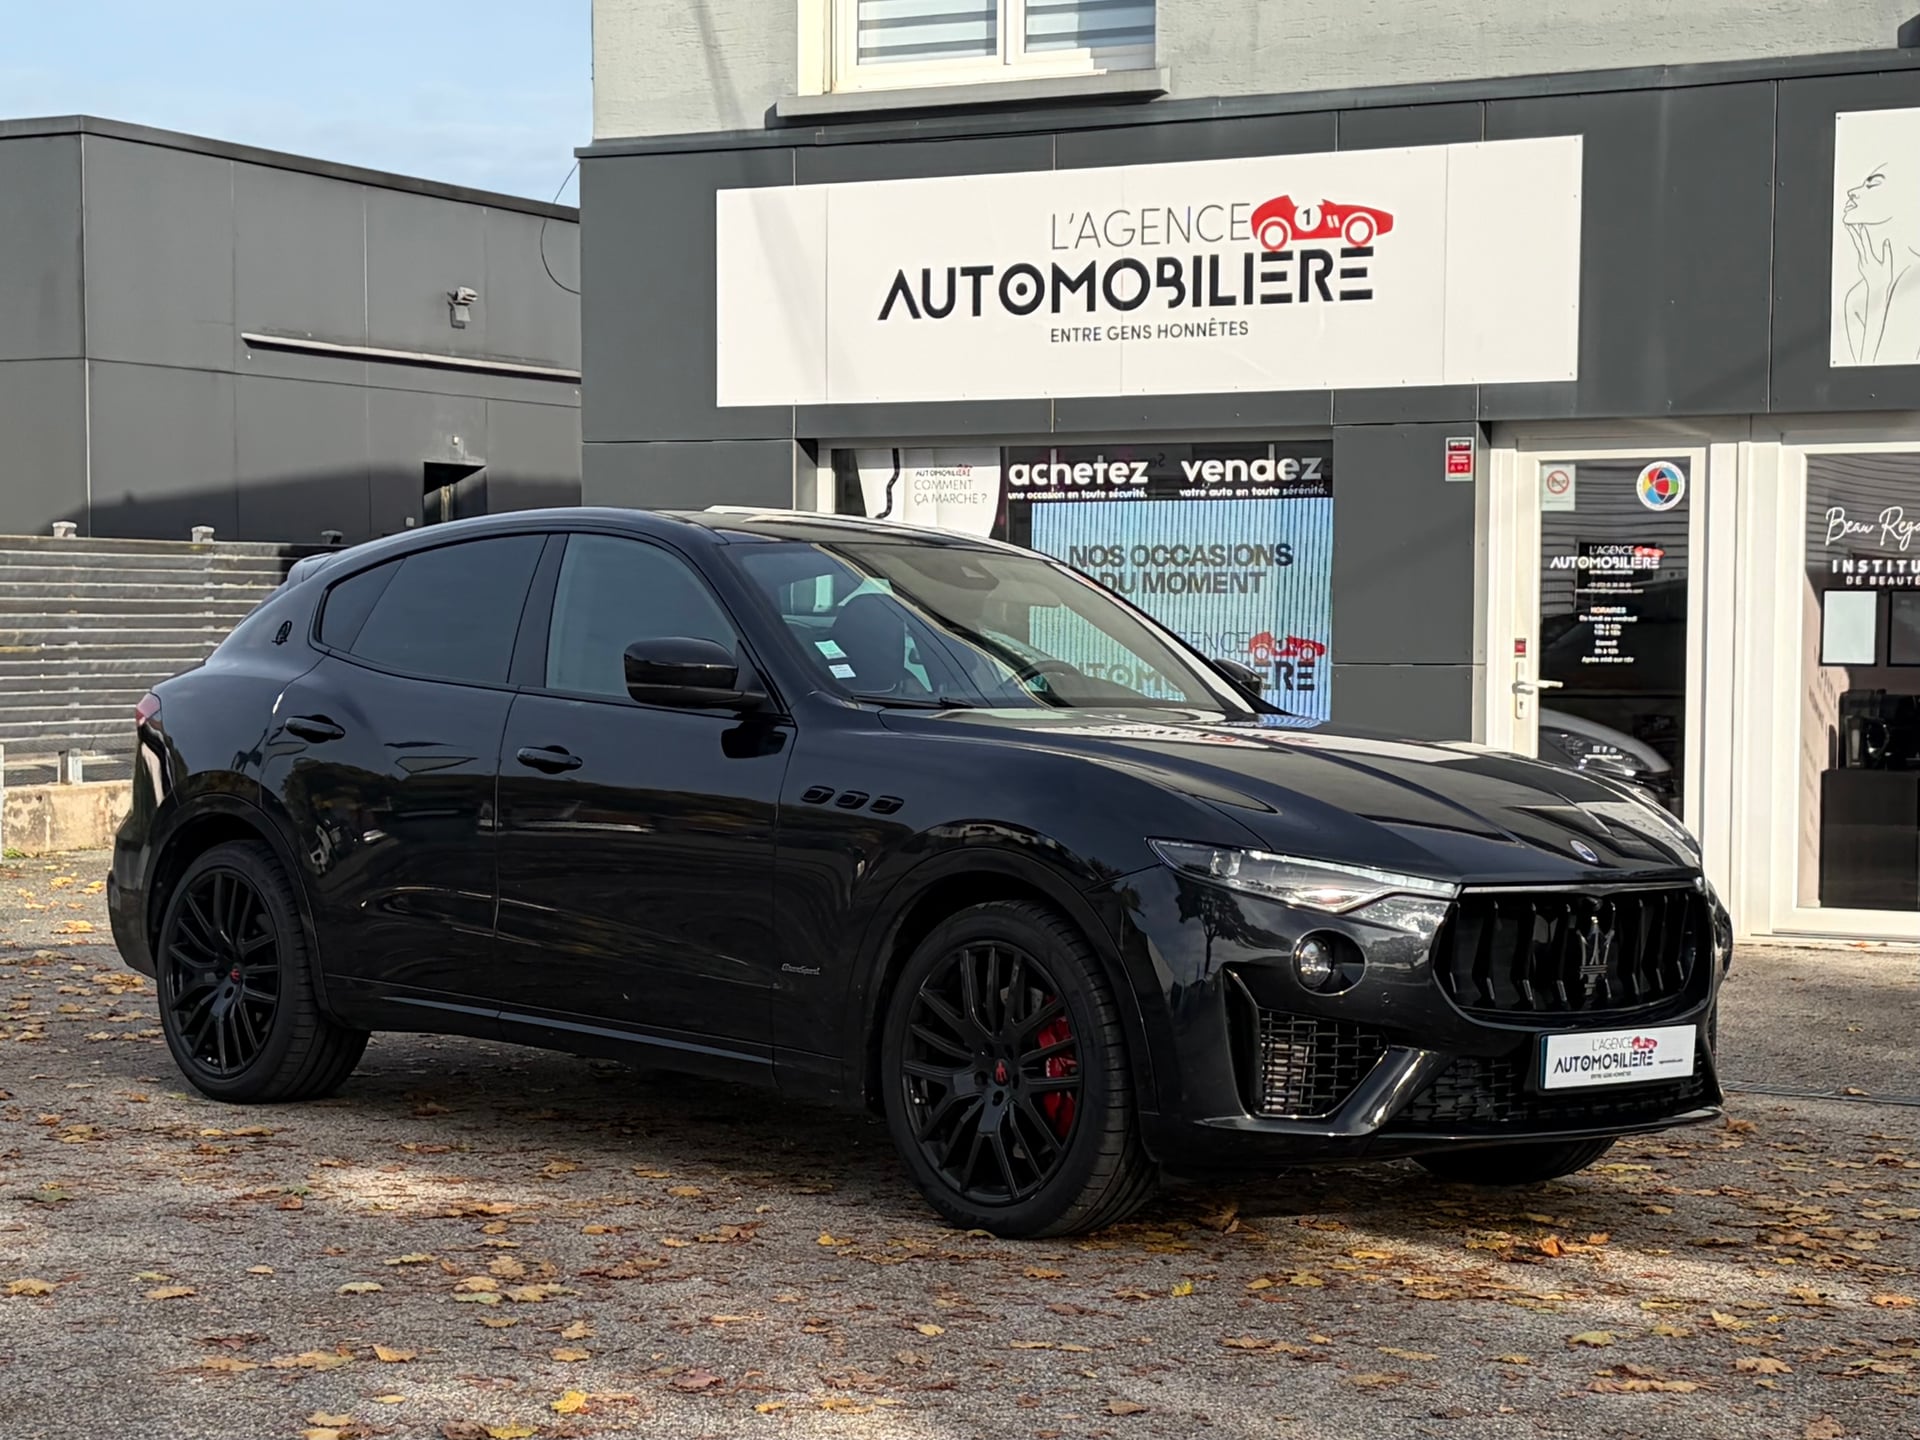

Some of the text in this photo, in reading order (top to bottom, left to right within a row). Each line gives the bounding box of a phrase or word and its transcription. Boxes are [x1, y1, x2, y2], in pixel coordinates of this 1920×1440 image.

[1051, 203, 1251, 250] L'AGENCE
[1050, 318, 1249, 343] ENTRE GENS HONNÊTES
[1008, 448, 1149, 486] achetez
[1180, 443, 1322, 483] vendez
[914, 479, 973, 490] COMMENT
[1008, 491, 1025, 500] une
[1027, 487, 1065, 500] occasion
[1067, 491, 1079, 499] en
[1081, 490, 1106, 499] toute
[1208, 487, 1232, 497] auto
[1235, 488, 1248, 496] en
[1251, 486, 1279, 496] toute
[914, 493, 929, 506] ÇA
[932, 493, 978, 504] MARCHE
[1825, 506, 1874, 546] Beau
[1069, 543, 1294, 567] NOS OCCASIONS
[1589, 545, 1634, 556] L'AGENCE
[1100, 571, 1267, 594] DU MOMENT
[1846, 576, 1863, 585] DE
[1592, 1036, 1633, 1051] L'AGENCE
